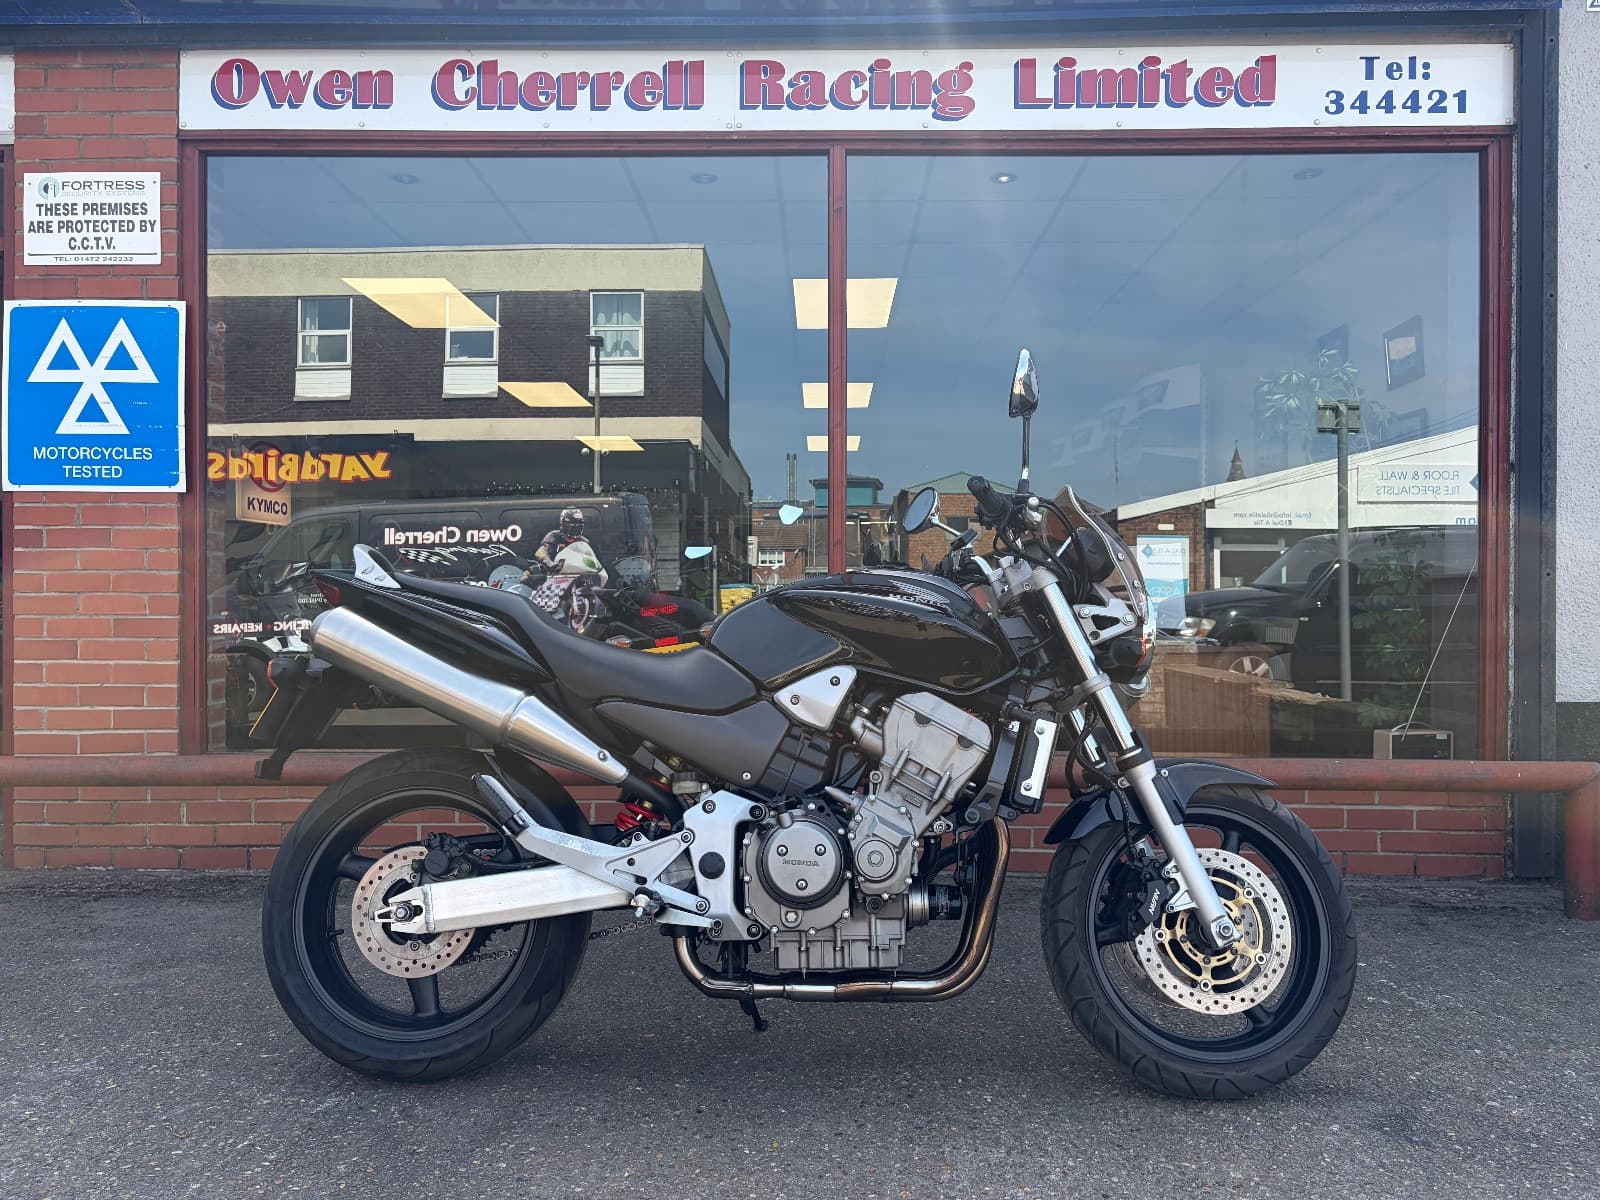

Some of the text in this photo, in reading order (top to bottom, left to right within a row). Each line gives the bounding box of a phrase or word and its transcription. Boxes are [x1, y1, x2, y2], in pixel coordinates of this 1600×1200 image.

[1359, 56, 1431, 81] Tel:
[210, 55, 1277, 122] Owen Cherrell Racing Limited
[1324, 89, 1467, 115] 344421
[61, 180, 146, 191] FORTRESS
[35, 202, 149, 217] THESE PREMISES
[27, 219, 157, 234] ARE PROTECTED BY
[68, 236, 116, 251] C.C.T.V.
[32, 446, 153, 461] MOTORCYCLES
[62, 465, 123, 479] TESTED
[246, 496, 288, 516] KYMCO
